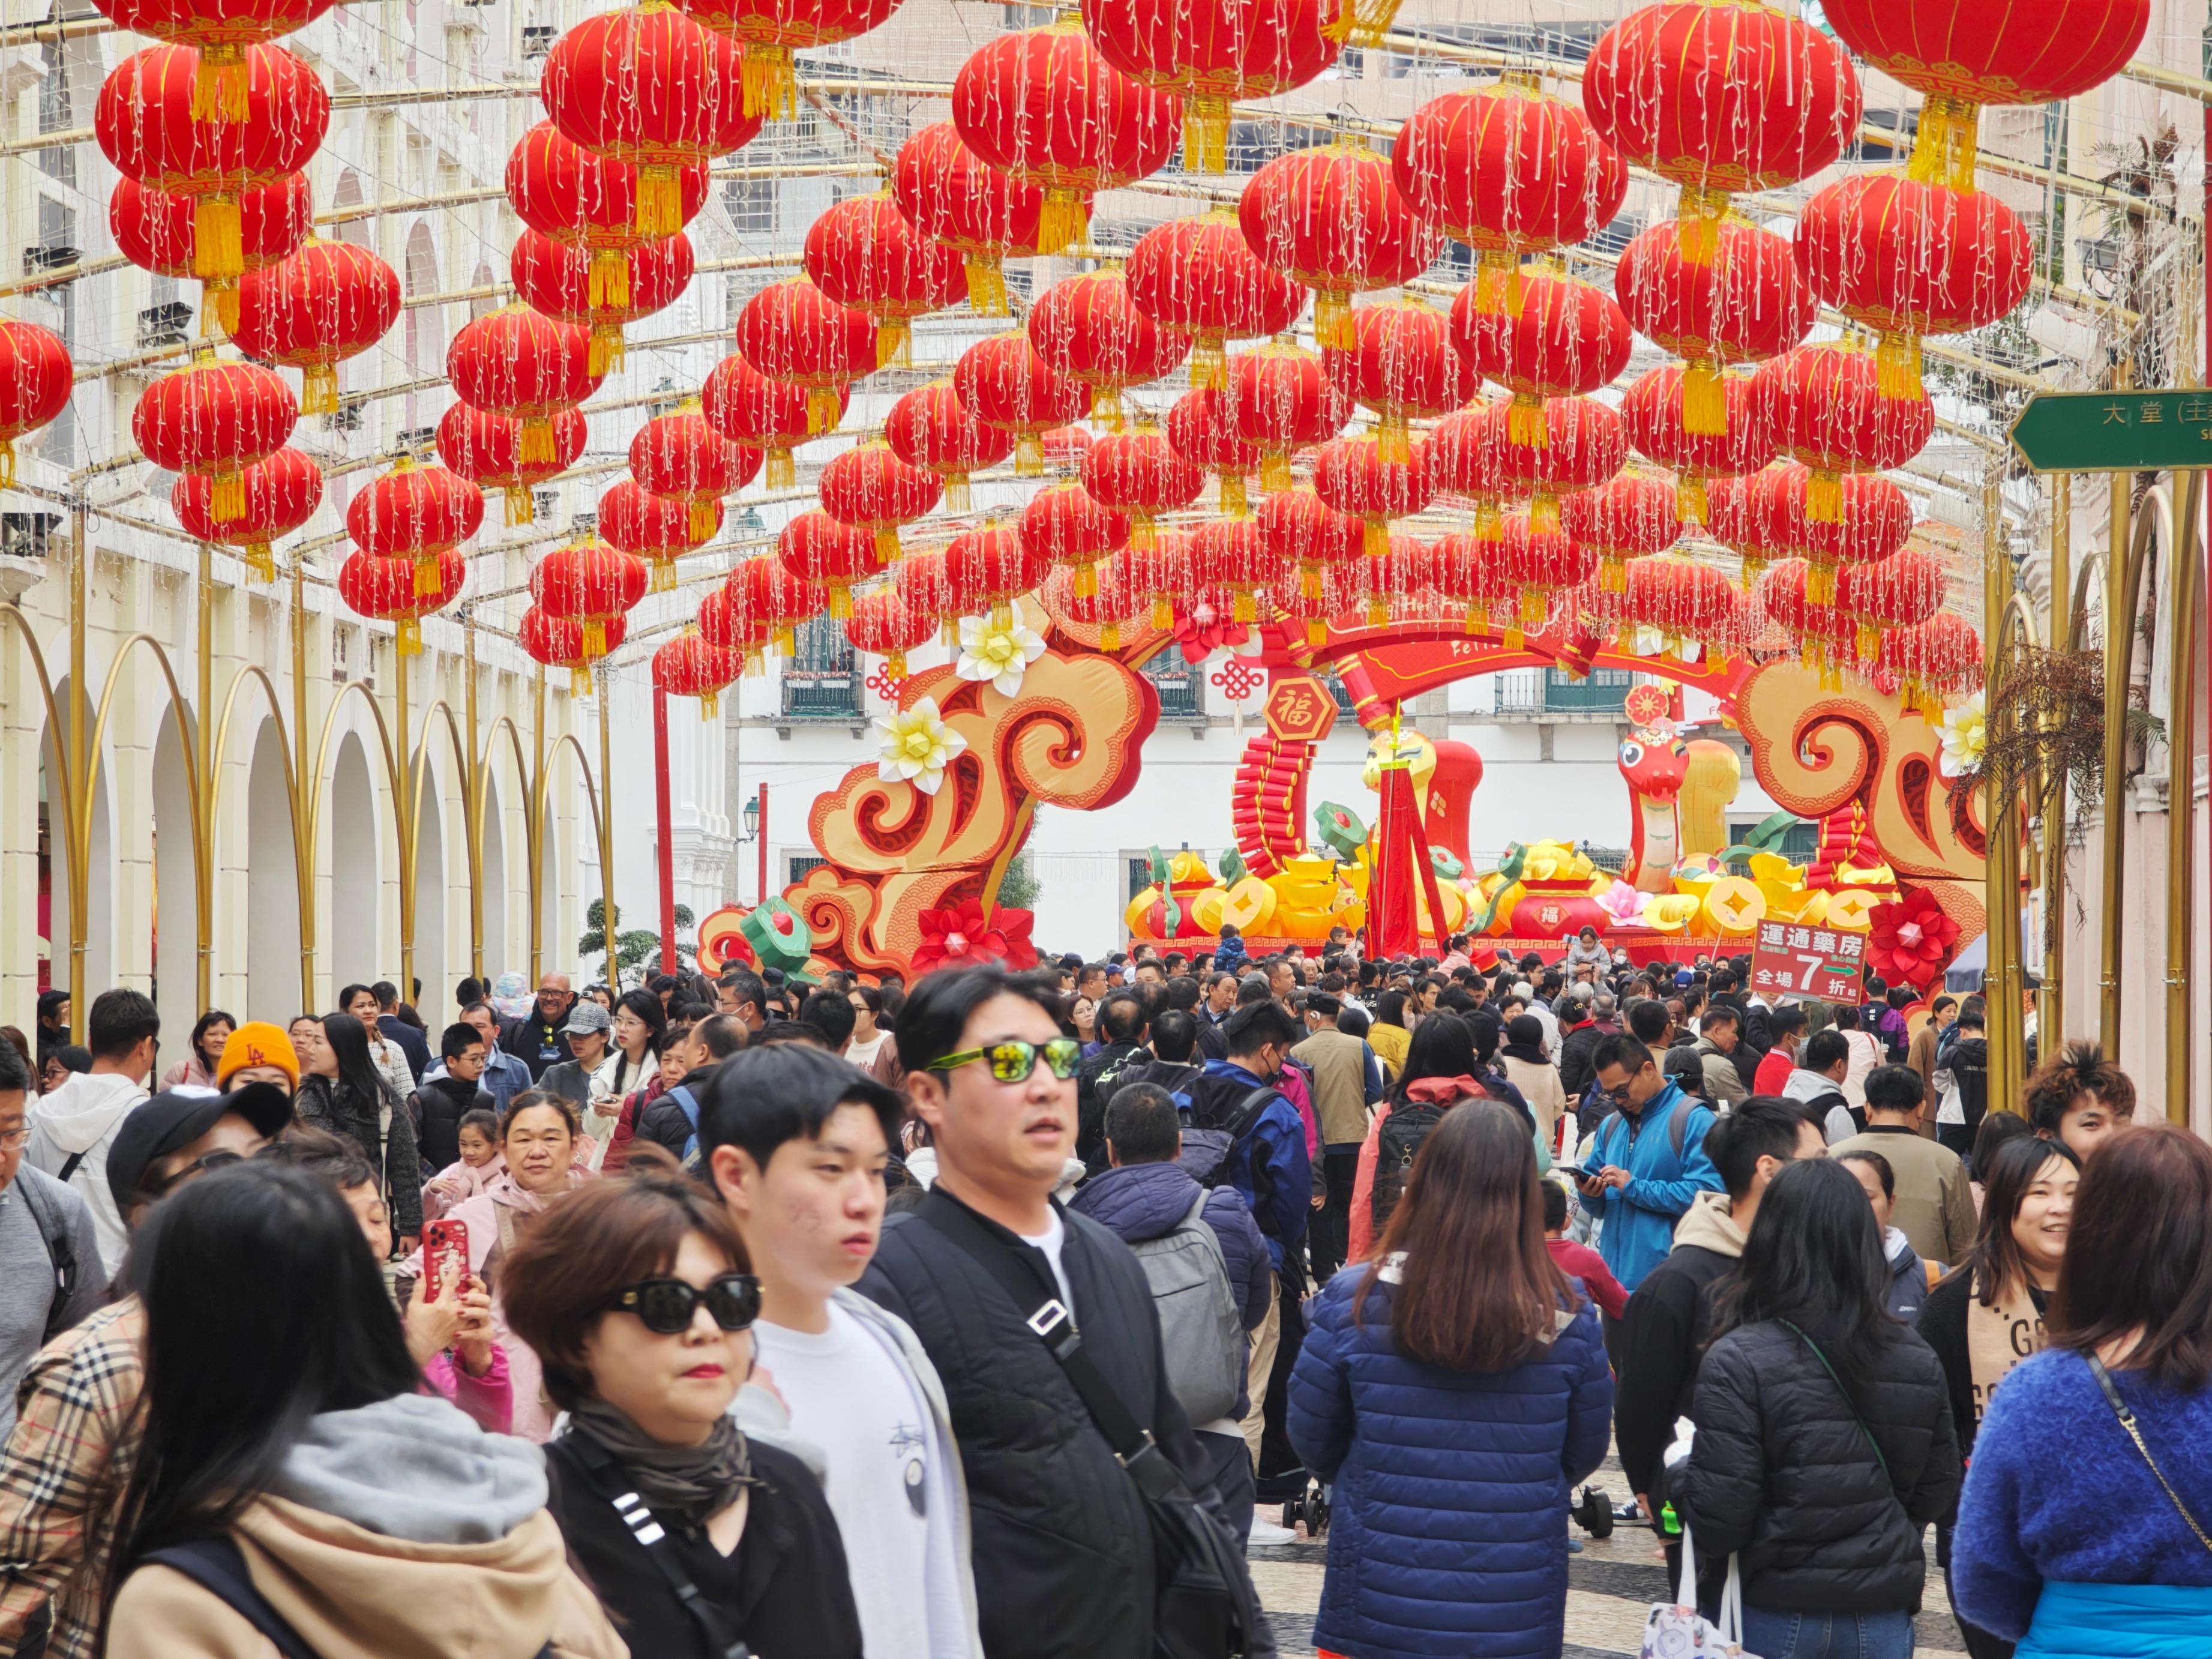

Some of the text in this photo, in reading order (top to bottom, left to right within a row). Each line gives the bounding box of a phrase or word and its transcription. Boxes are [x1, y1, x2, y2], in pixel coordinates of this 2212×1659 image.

[1276, 689, 1312, 726] 福
[1541, 906, 1560, 923] 福
[1760, 923, 1862, 956] 運通藥房
[1796, 954, 1823, 990] 7
[247, 1043, 266, 1065] LA
